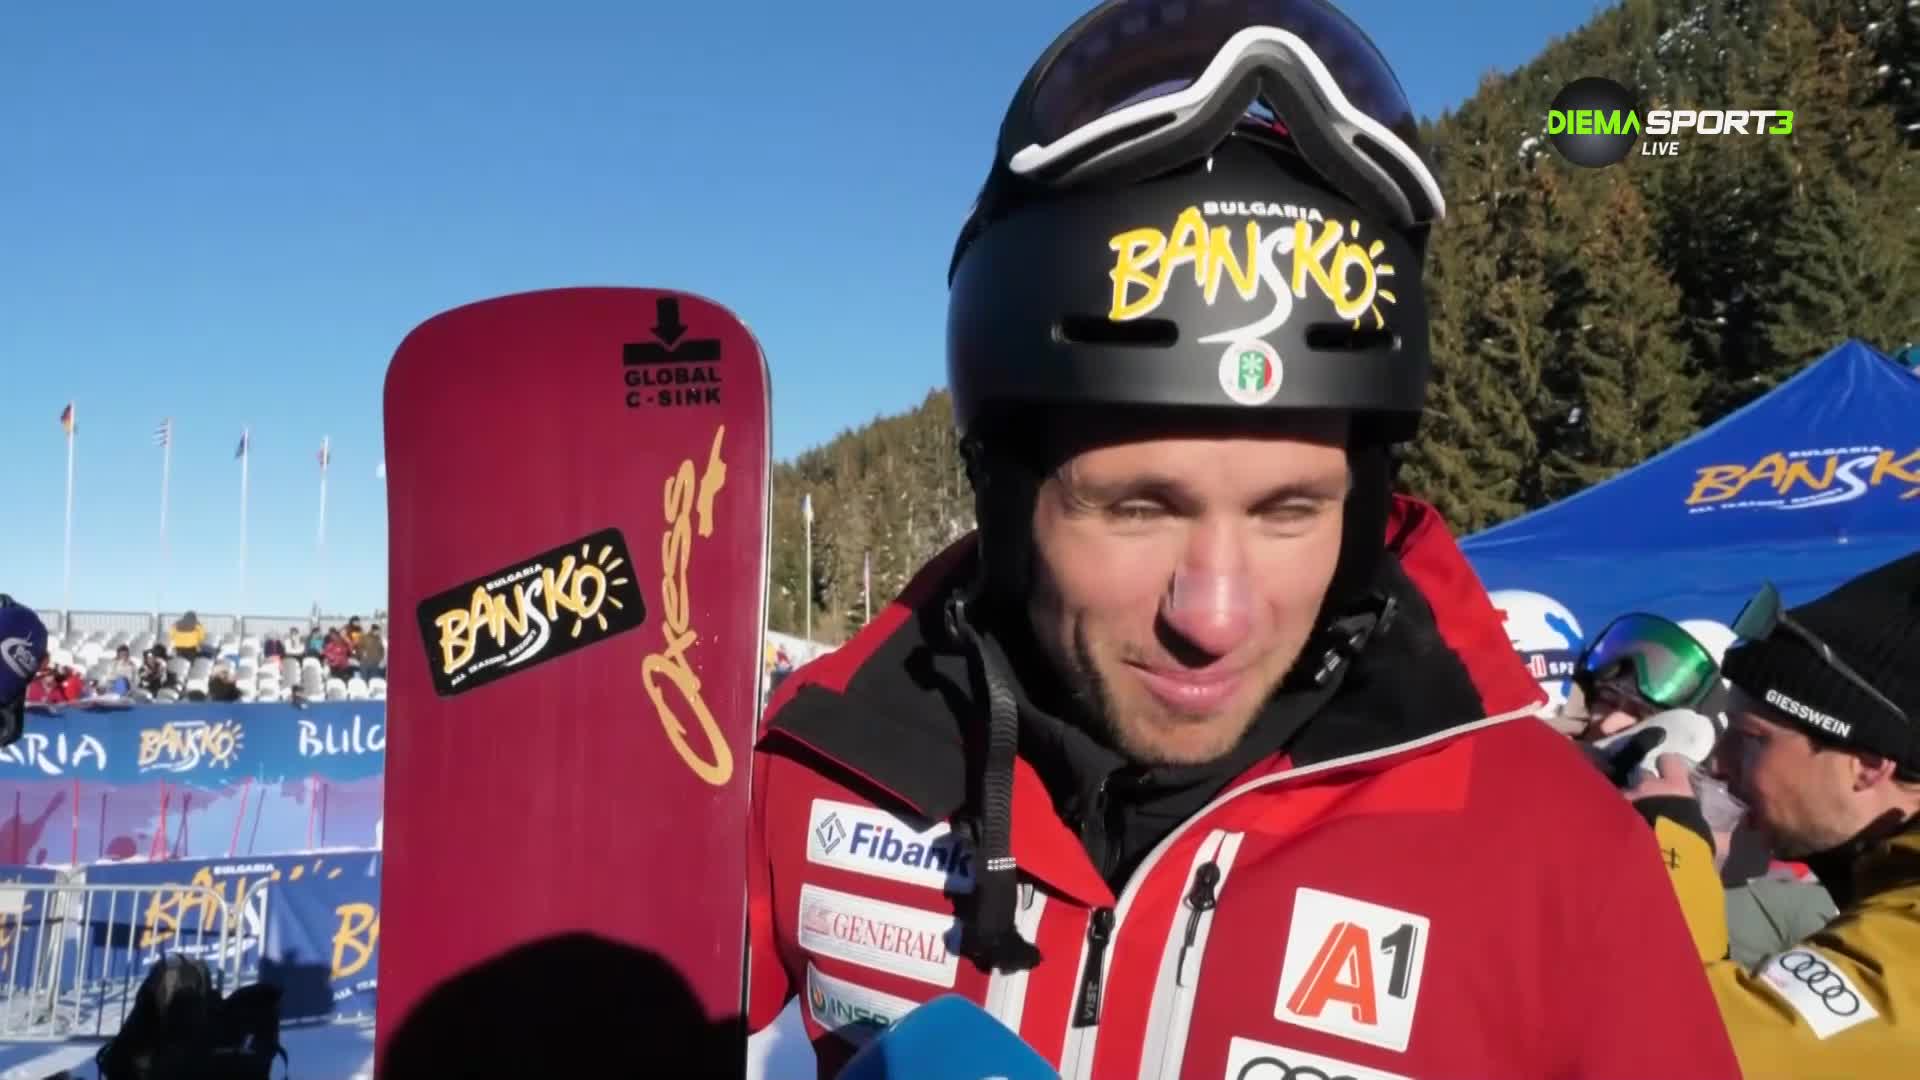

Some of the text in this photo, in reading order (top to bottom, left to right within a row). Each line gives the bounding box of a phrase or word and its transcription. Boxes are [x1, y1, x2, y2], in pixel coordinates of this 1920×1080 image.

[1203, 201, 1324, 222] BULGARIA
[1108, 206, 1378, 343] BANSKO
[623, 366, 723, 387] GLOBAL
[1685, 449, 1920, 509] BANSK
[486, 563, 543, 591] BULGARIA
[435, 555, 607, 675] BANSKO
[1765, 688, 1852, 738] GIESSWEIN
[138, 721, 236, 773] BANSKO
[850, 821, 973, 877] Fibank
[1286, 920, 1419, 1025] A1
